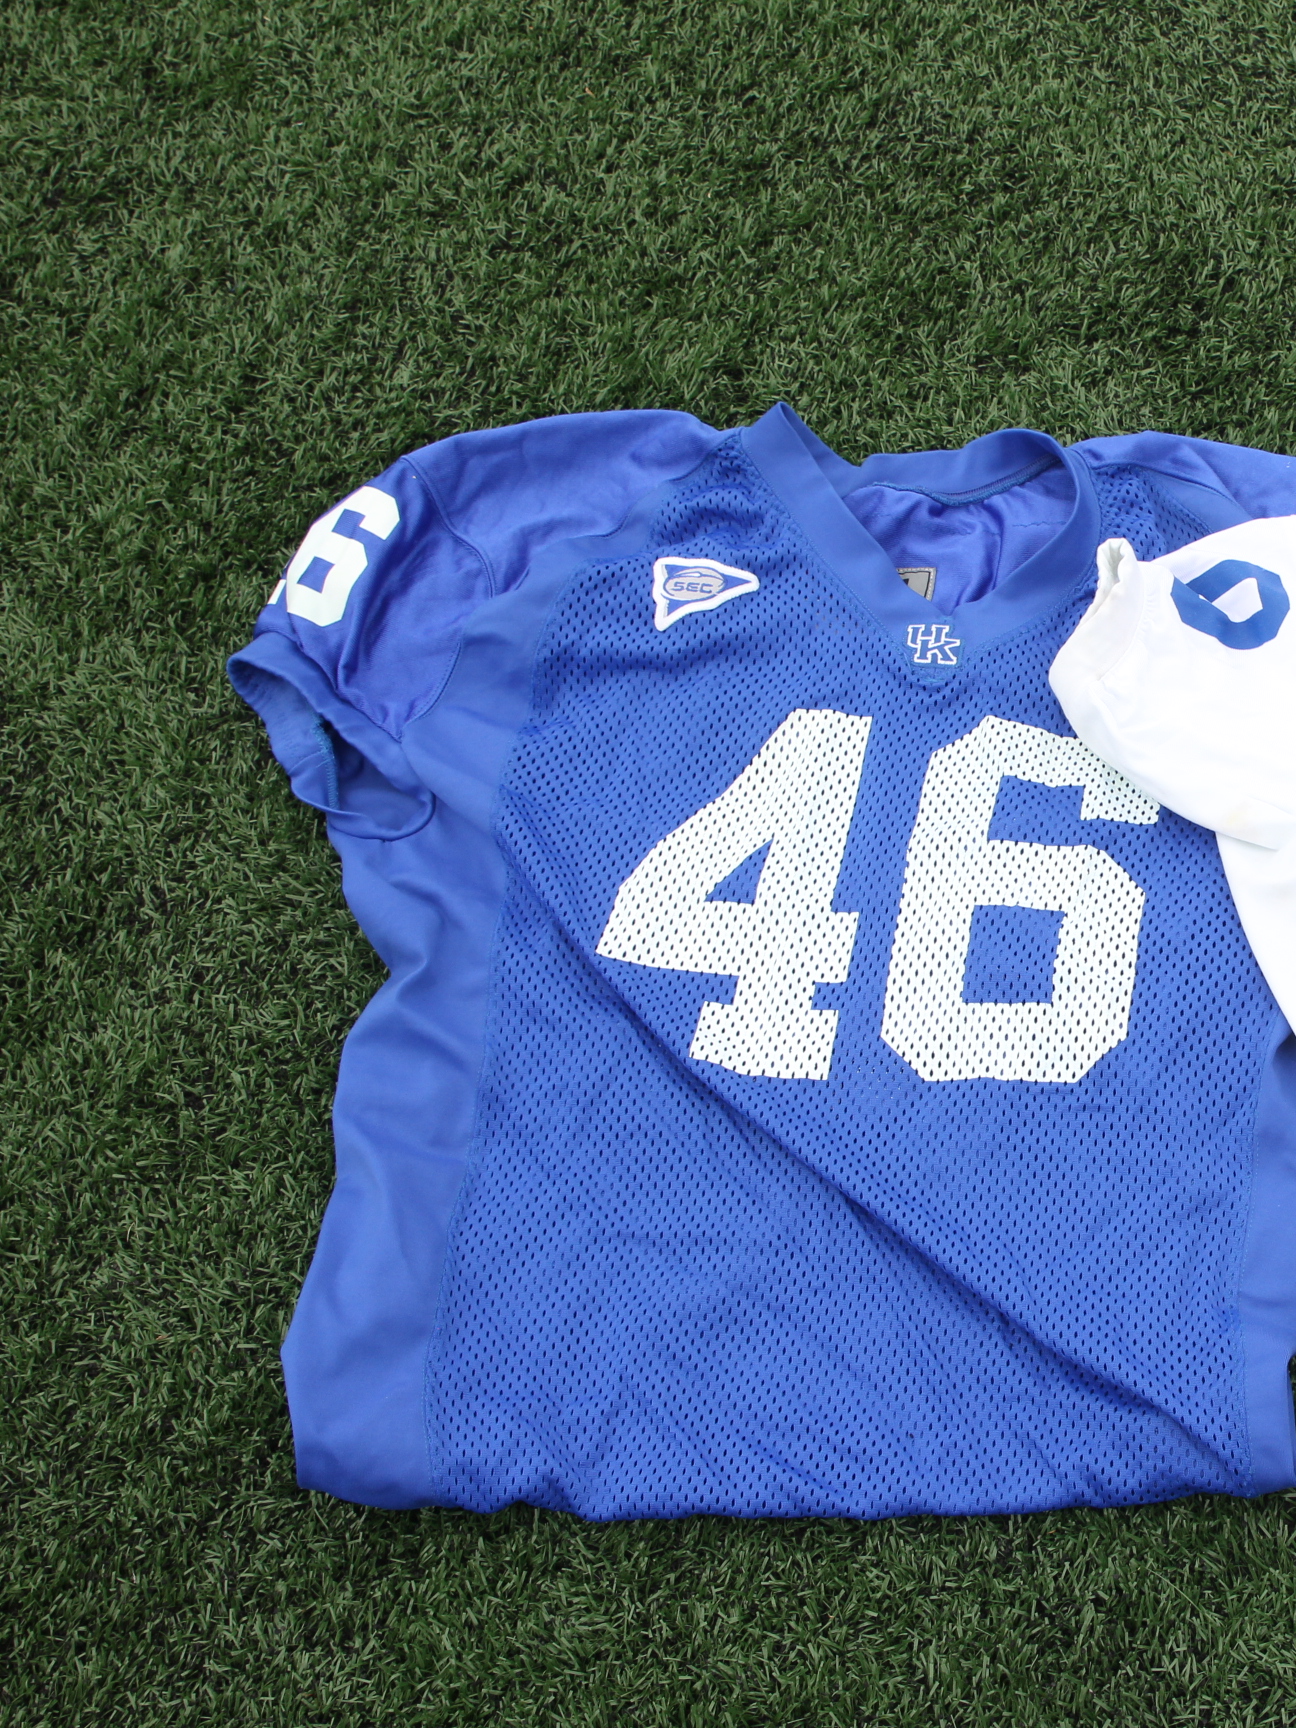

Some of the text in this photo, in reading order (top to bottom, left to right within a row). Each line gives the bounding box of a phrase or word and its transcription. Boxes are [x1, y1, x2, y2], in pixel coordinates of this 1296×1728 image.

[671, 581, 713, 594] SEC
[906, 623, 961, 665] UK
[596, 708, 1160, 1083] 46
